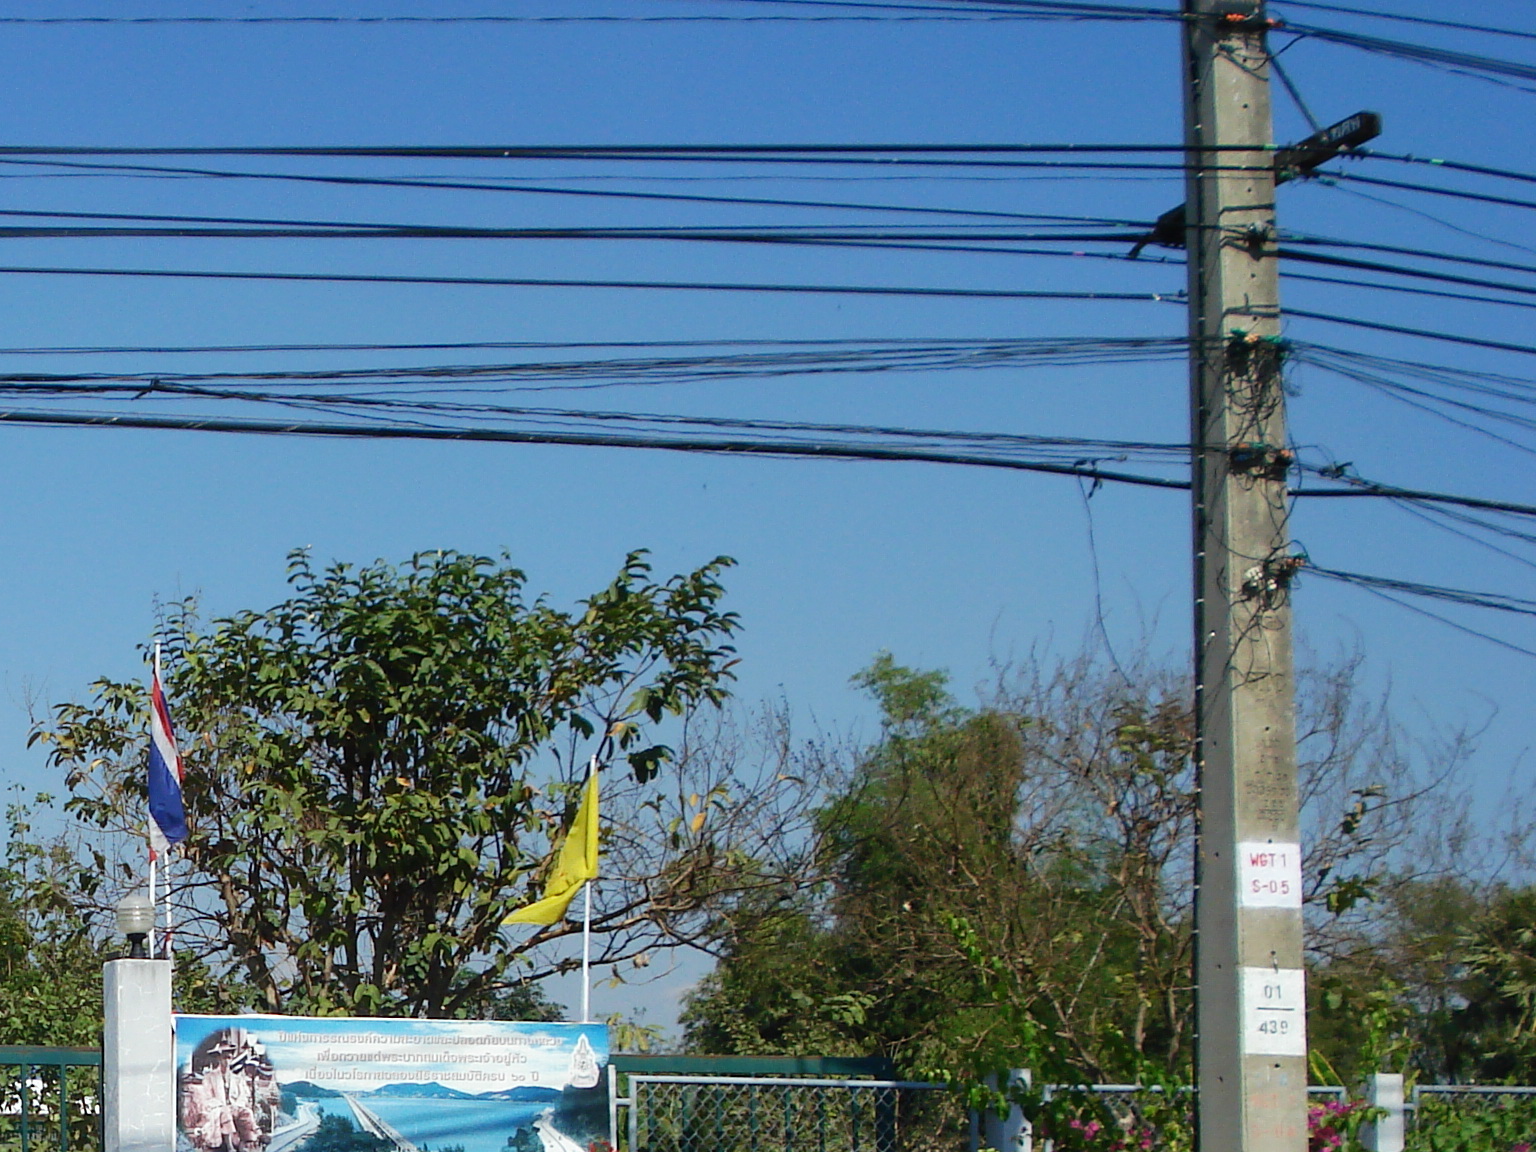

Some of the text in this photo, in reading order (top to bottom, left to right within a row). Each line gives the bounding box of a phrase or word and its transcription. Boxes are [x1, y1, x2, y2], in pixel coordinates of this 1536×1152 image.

[1249, 852, 1287, 867] WGT 1
[1252, 879, 1290, 895] S-05
[1264, 985, 1281, 999] 01
[1259, 1020, 1289, 1035] 439
[530, 1070, 540, 1082] ปี
